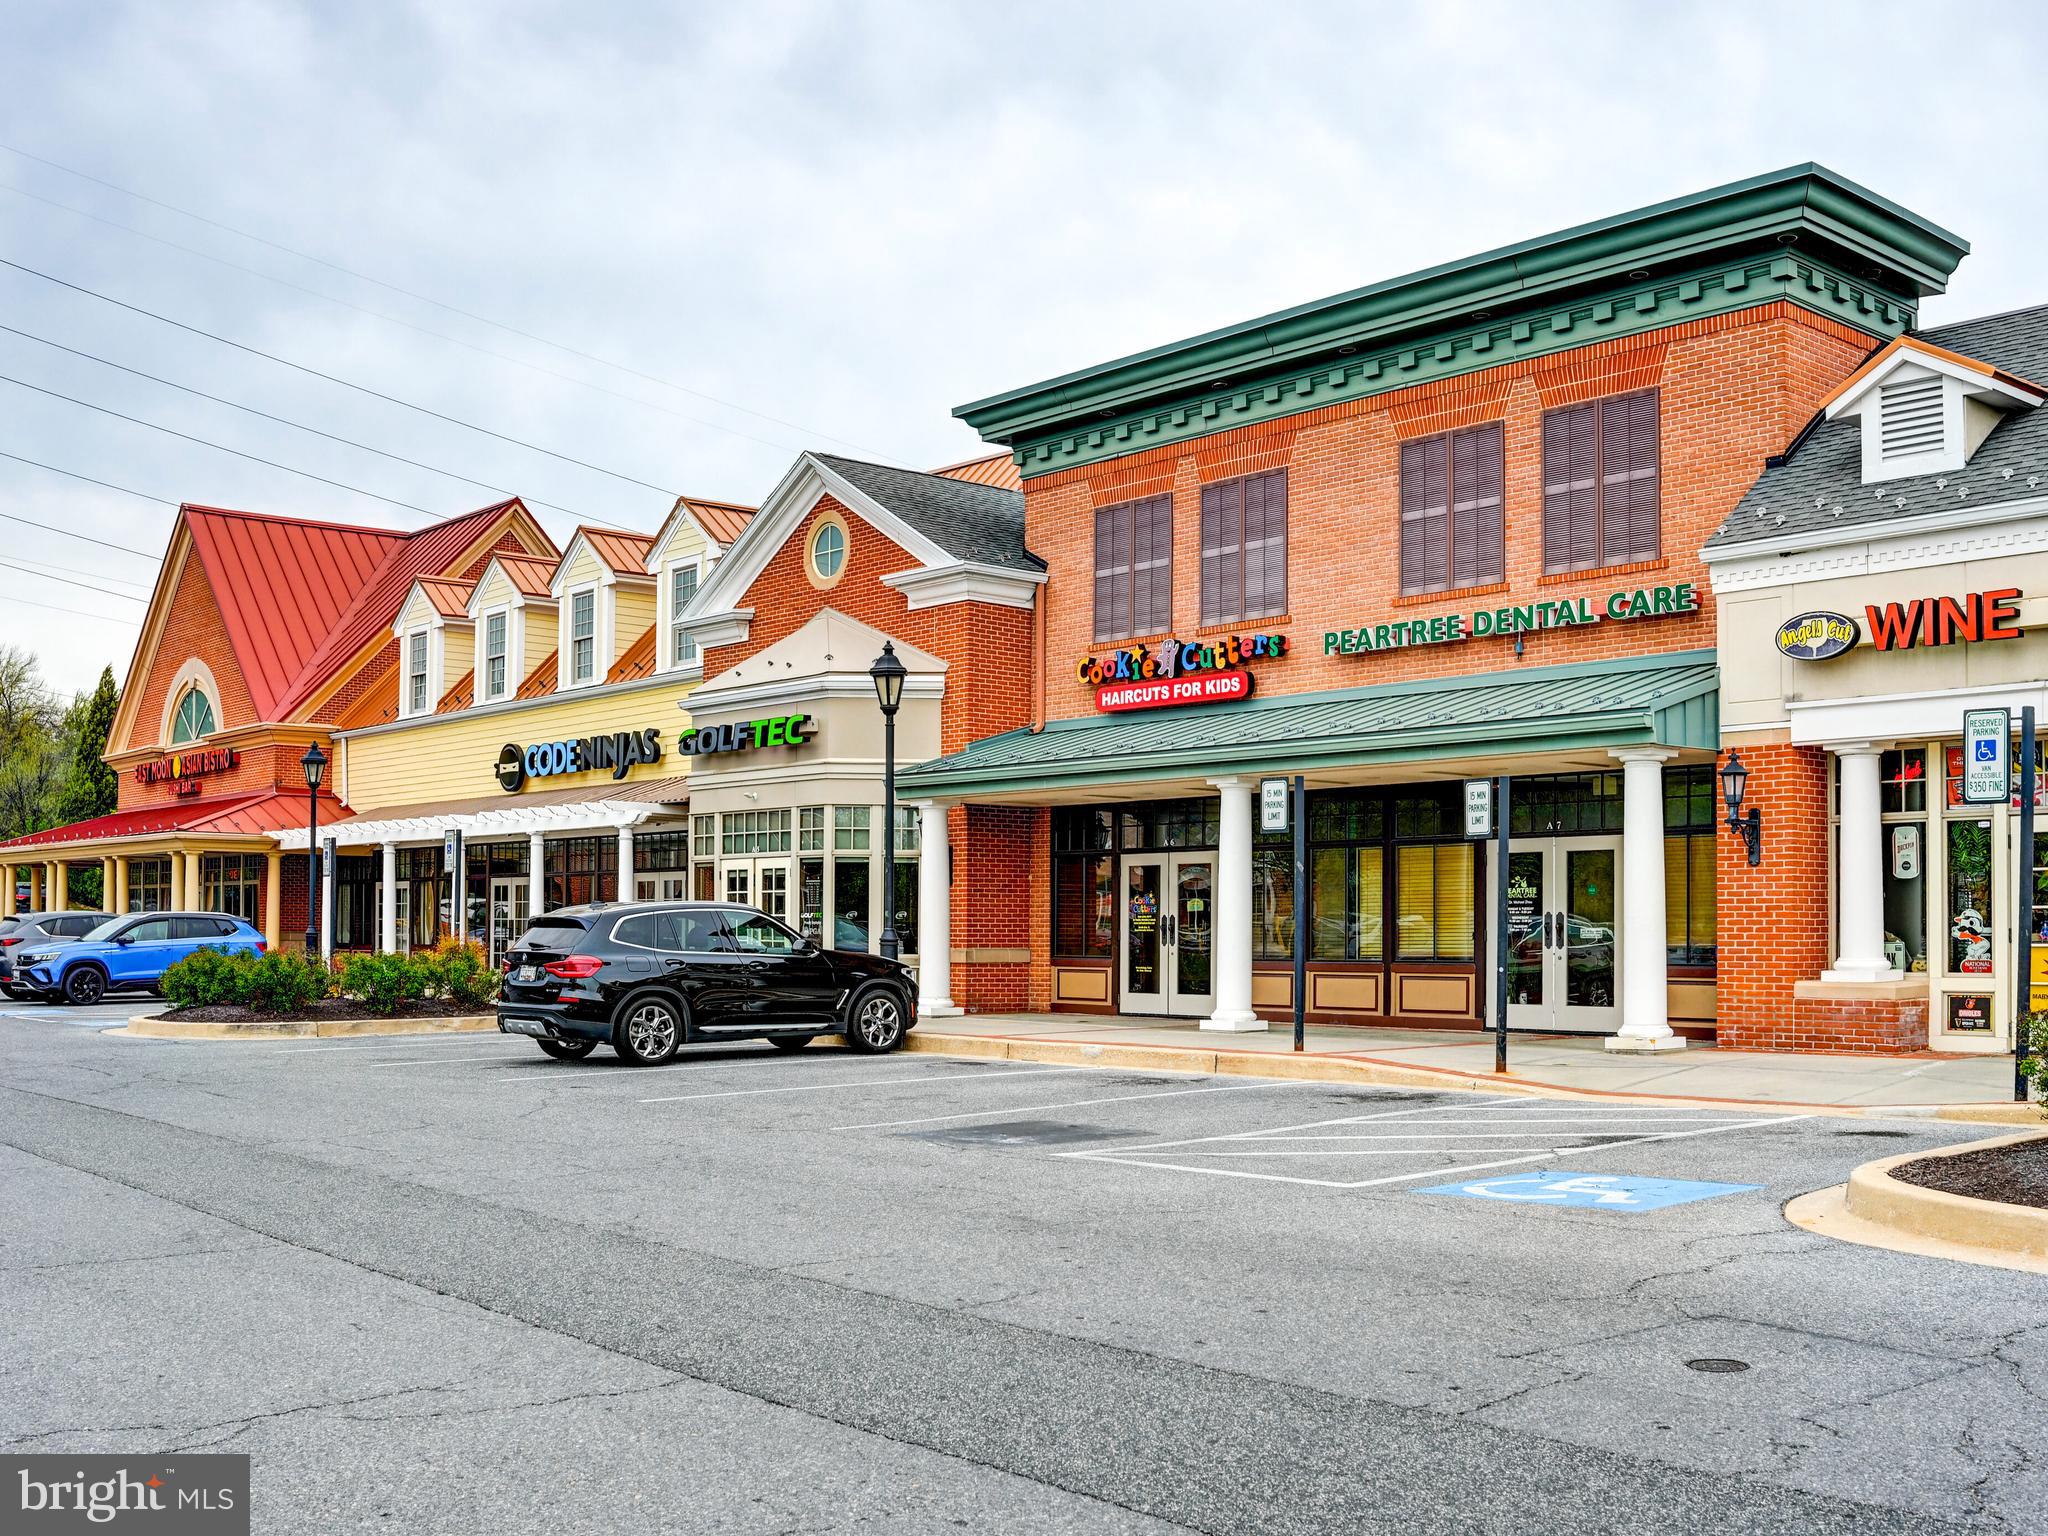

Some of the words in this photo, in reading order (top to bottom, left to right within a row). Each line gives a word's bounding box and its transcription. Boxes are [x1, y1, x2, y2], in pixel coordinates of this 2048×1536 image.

[1324, 614, 1465, 655] PEARTREE
[1473, 597, 1598, 637] DENTAL
[1607, 583, 1697, 619] CARE
[1865, 588, 2022, 651] WINE
[1781, 619, 1823, 649] Angels
[1827, 619, 1852, 641] Cut
[1181, 635, 1282, 671] Cutters
[1101, 686, 1169, 706] HAIRCUTS
[1173, 682, 1201, 698] FOR
[1205, 676, 1241, 695] KIDS
[1969, 718, 2003, 728] RESERVED
[678, 714, 808, 756] GOLFTEC
[1972, 727, 2000, 737] PARKING
[133, 760, 150, 785] EAST
[151, 758, 172, 781] MOON
[181, 753, 203, 776] ASIAN
[203, 747, 231, 772] BISTRO
[1969, 781, 1987, 792] $350
[1988, 780, 2004, 792] FINE
[1266, 789, 1272, 798] 15
[1273, 788, 1283, 797] MIN
[1470, 791, 1476, 800] 15
[1476, 790, 1487, 799] MIN
[1265, 800, 1285, 809] PARKING
[1468, 803, 1488, 813] PARKING
[1267, 811, 1281, 821] LIMIT
[1471, 815, 1484, 826] LIMIT
